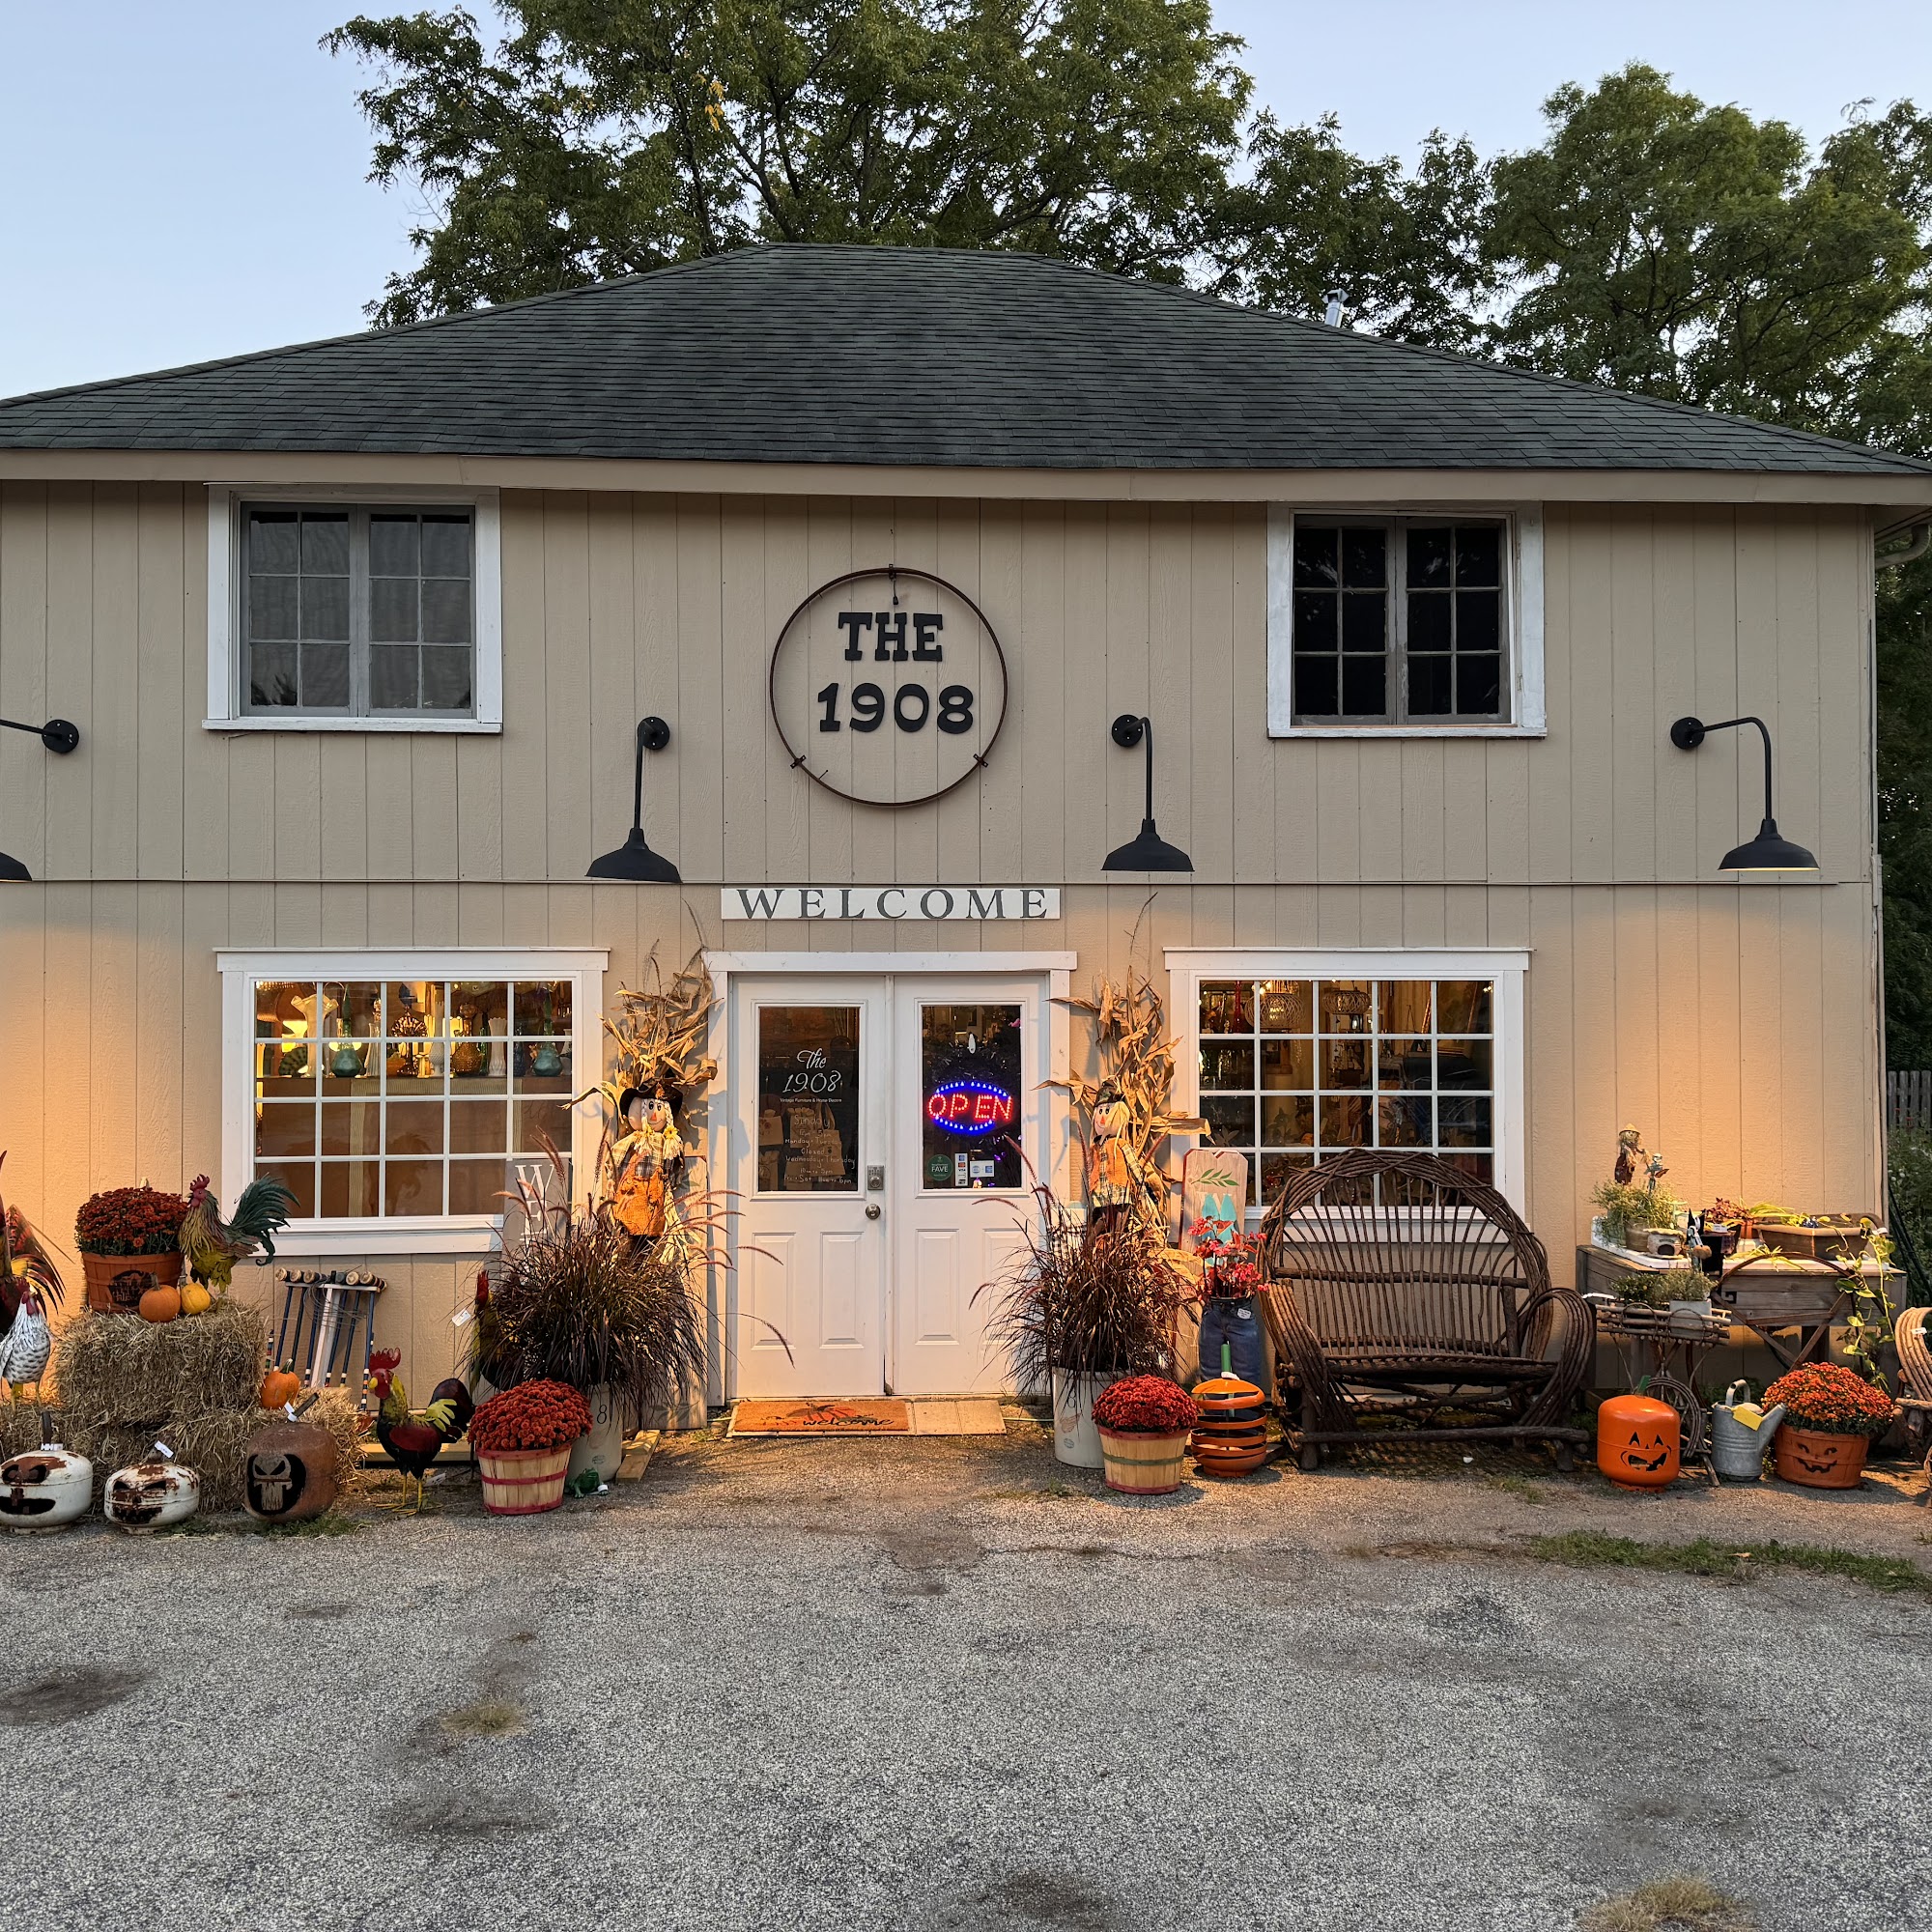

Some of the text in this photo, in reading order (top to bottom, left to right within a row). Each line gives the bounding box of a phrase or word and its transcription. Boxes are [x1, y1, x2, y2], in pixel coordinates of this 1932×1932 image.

[838, 611, 944, 662] THE
[817, 682, 974, 735] 1908
[736, 888, 1048, 920] WELCOME
[796, 1047, 827, 1069] The
[781, 1069, 842, 1094] 1908
[927, 1093, 1013, 1121] OPEN
[794, 1114, 830, 1129] Sunday
[784, 1138, 810, 1148] Monday
[596, 1404, 608, 1425] 8
[802, 1416, 895, 1428] welcome
